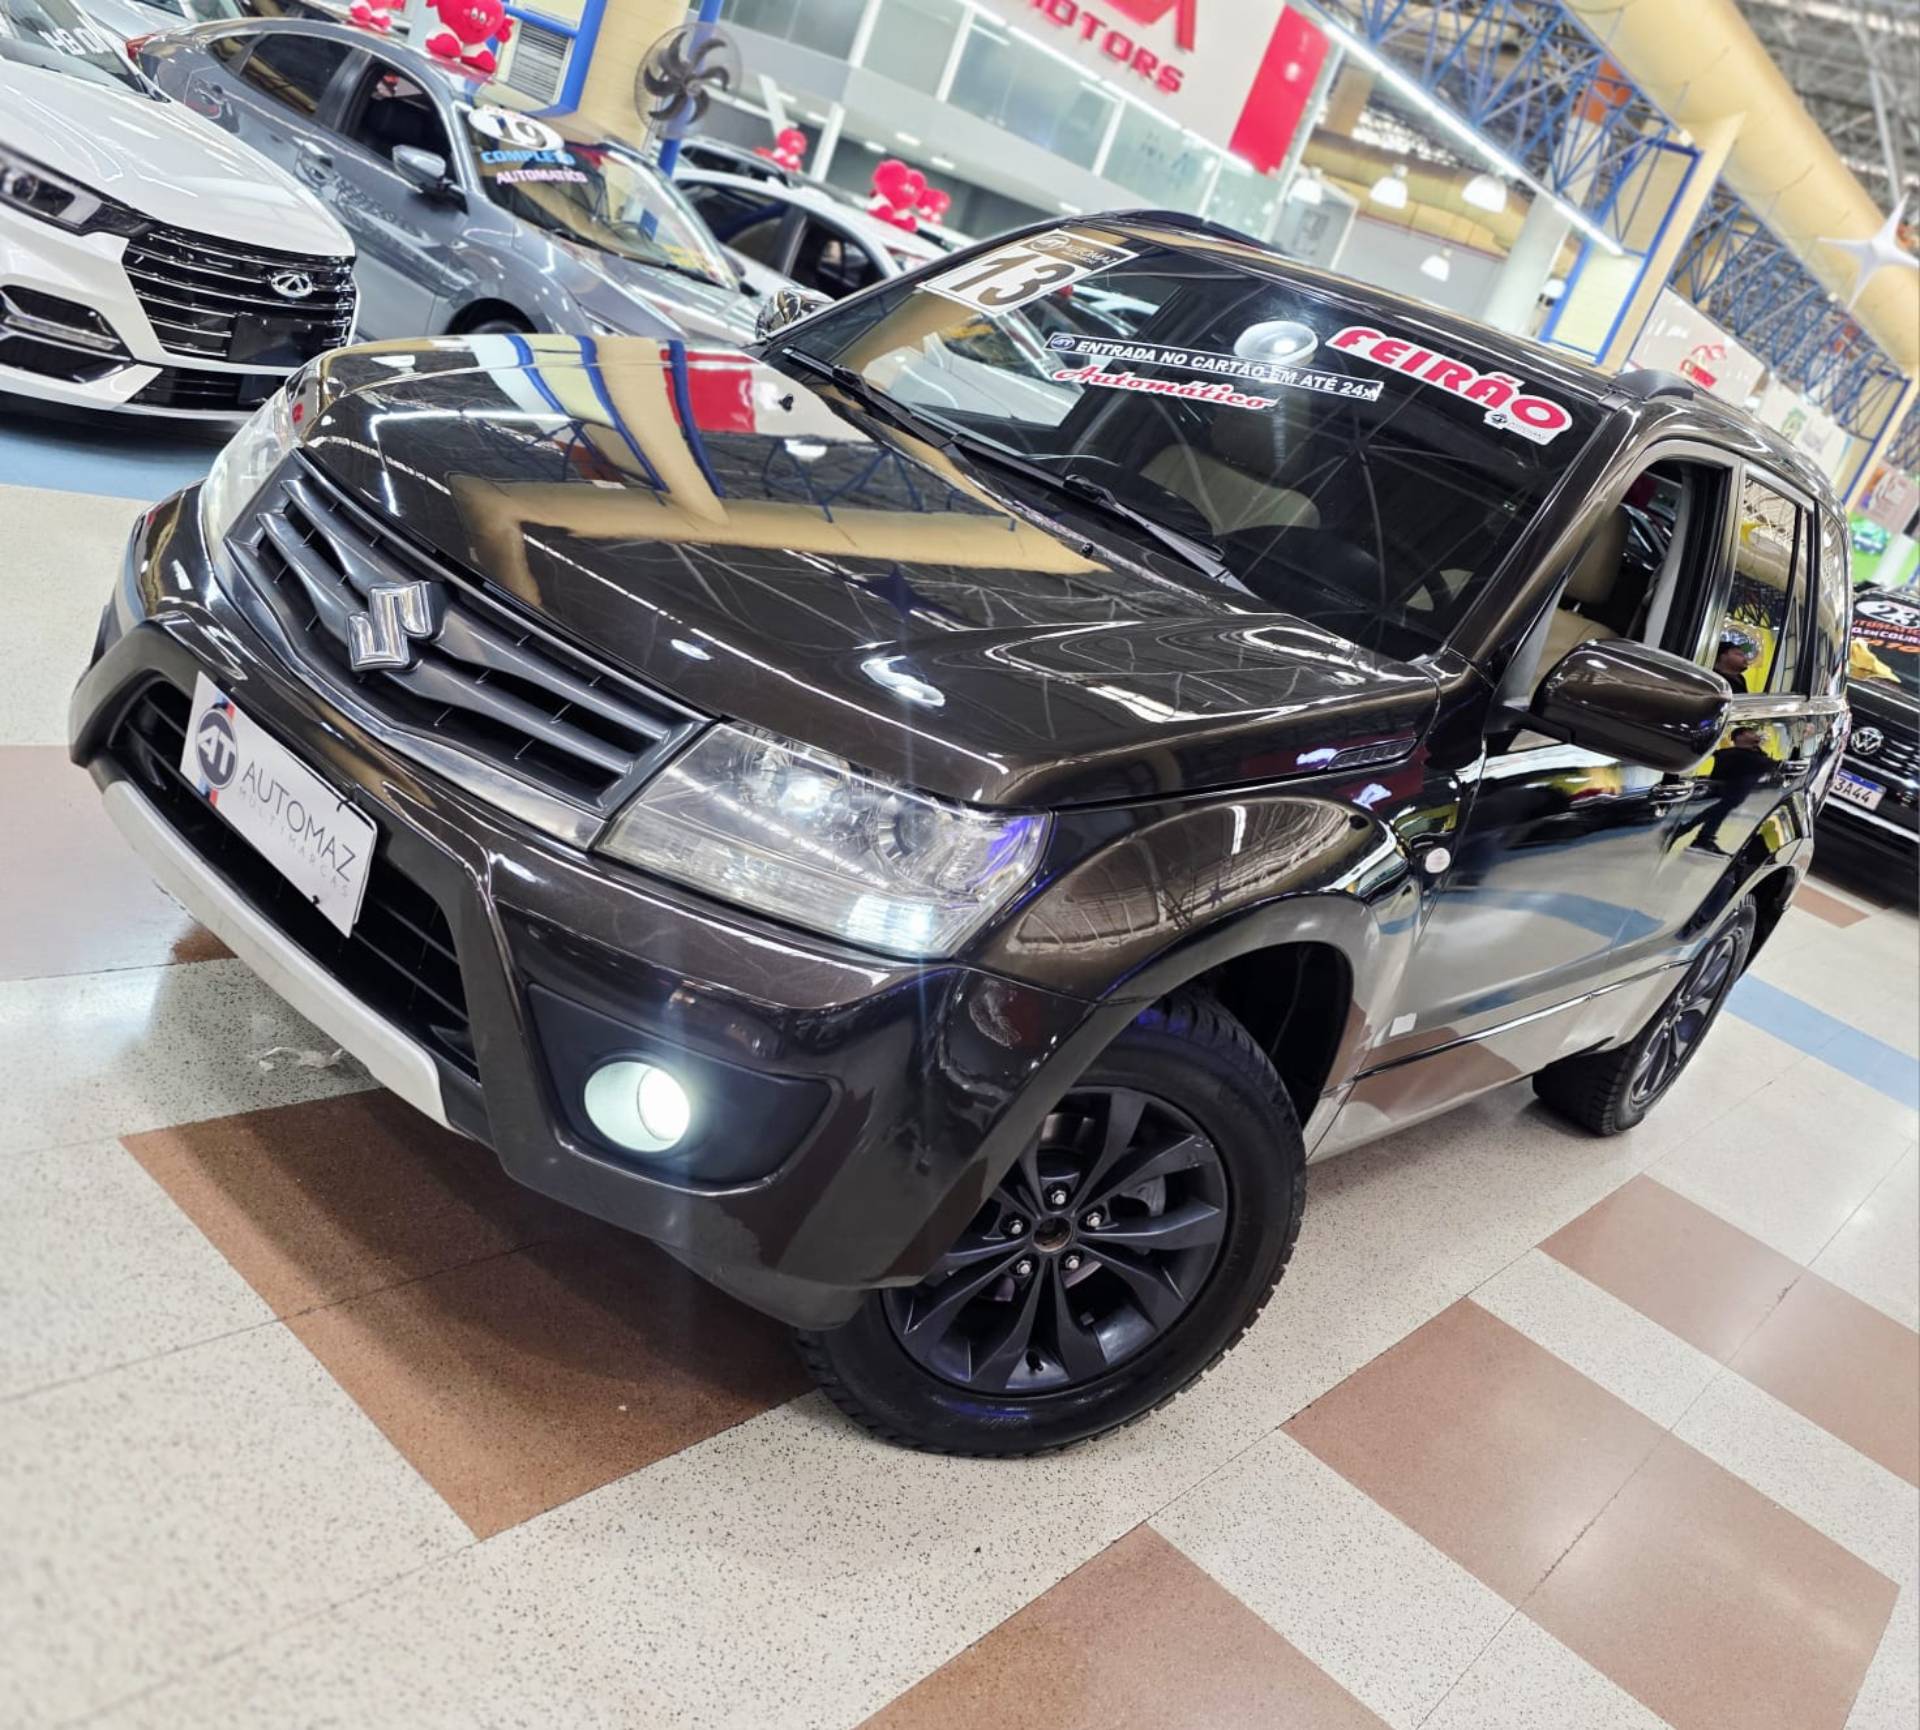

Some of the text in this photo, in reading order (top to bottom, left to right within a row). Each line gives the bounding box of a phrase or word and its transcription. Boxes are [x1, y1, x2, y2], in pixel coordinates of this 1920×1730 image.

[1030, 0, 1184, 95] OTORS
[948, 253, 1075, 306] 13
[1053, 365, 1275, 408] Automático
[1075, 340, 1157, 362] ENTRADA
[1160, 349, 1189, 366] NO
[1269, 366, 1298, 384] EM
[1300, 374, 1338, 391] ATÉ
[1332, 328, 1567, 430] FEIRÃO
[242, 760, 356, 882] AUTOMAZ
